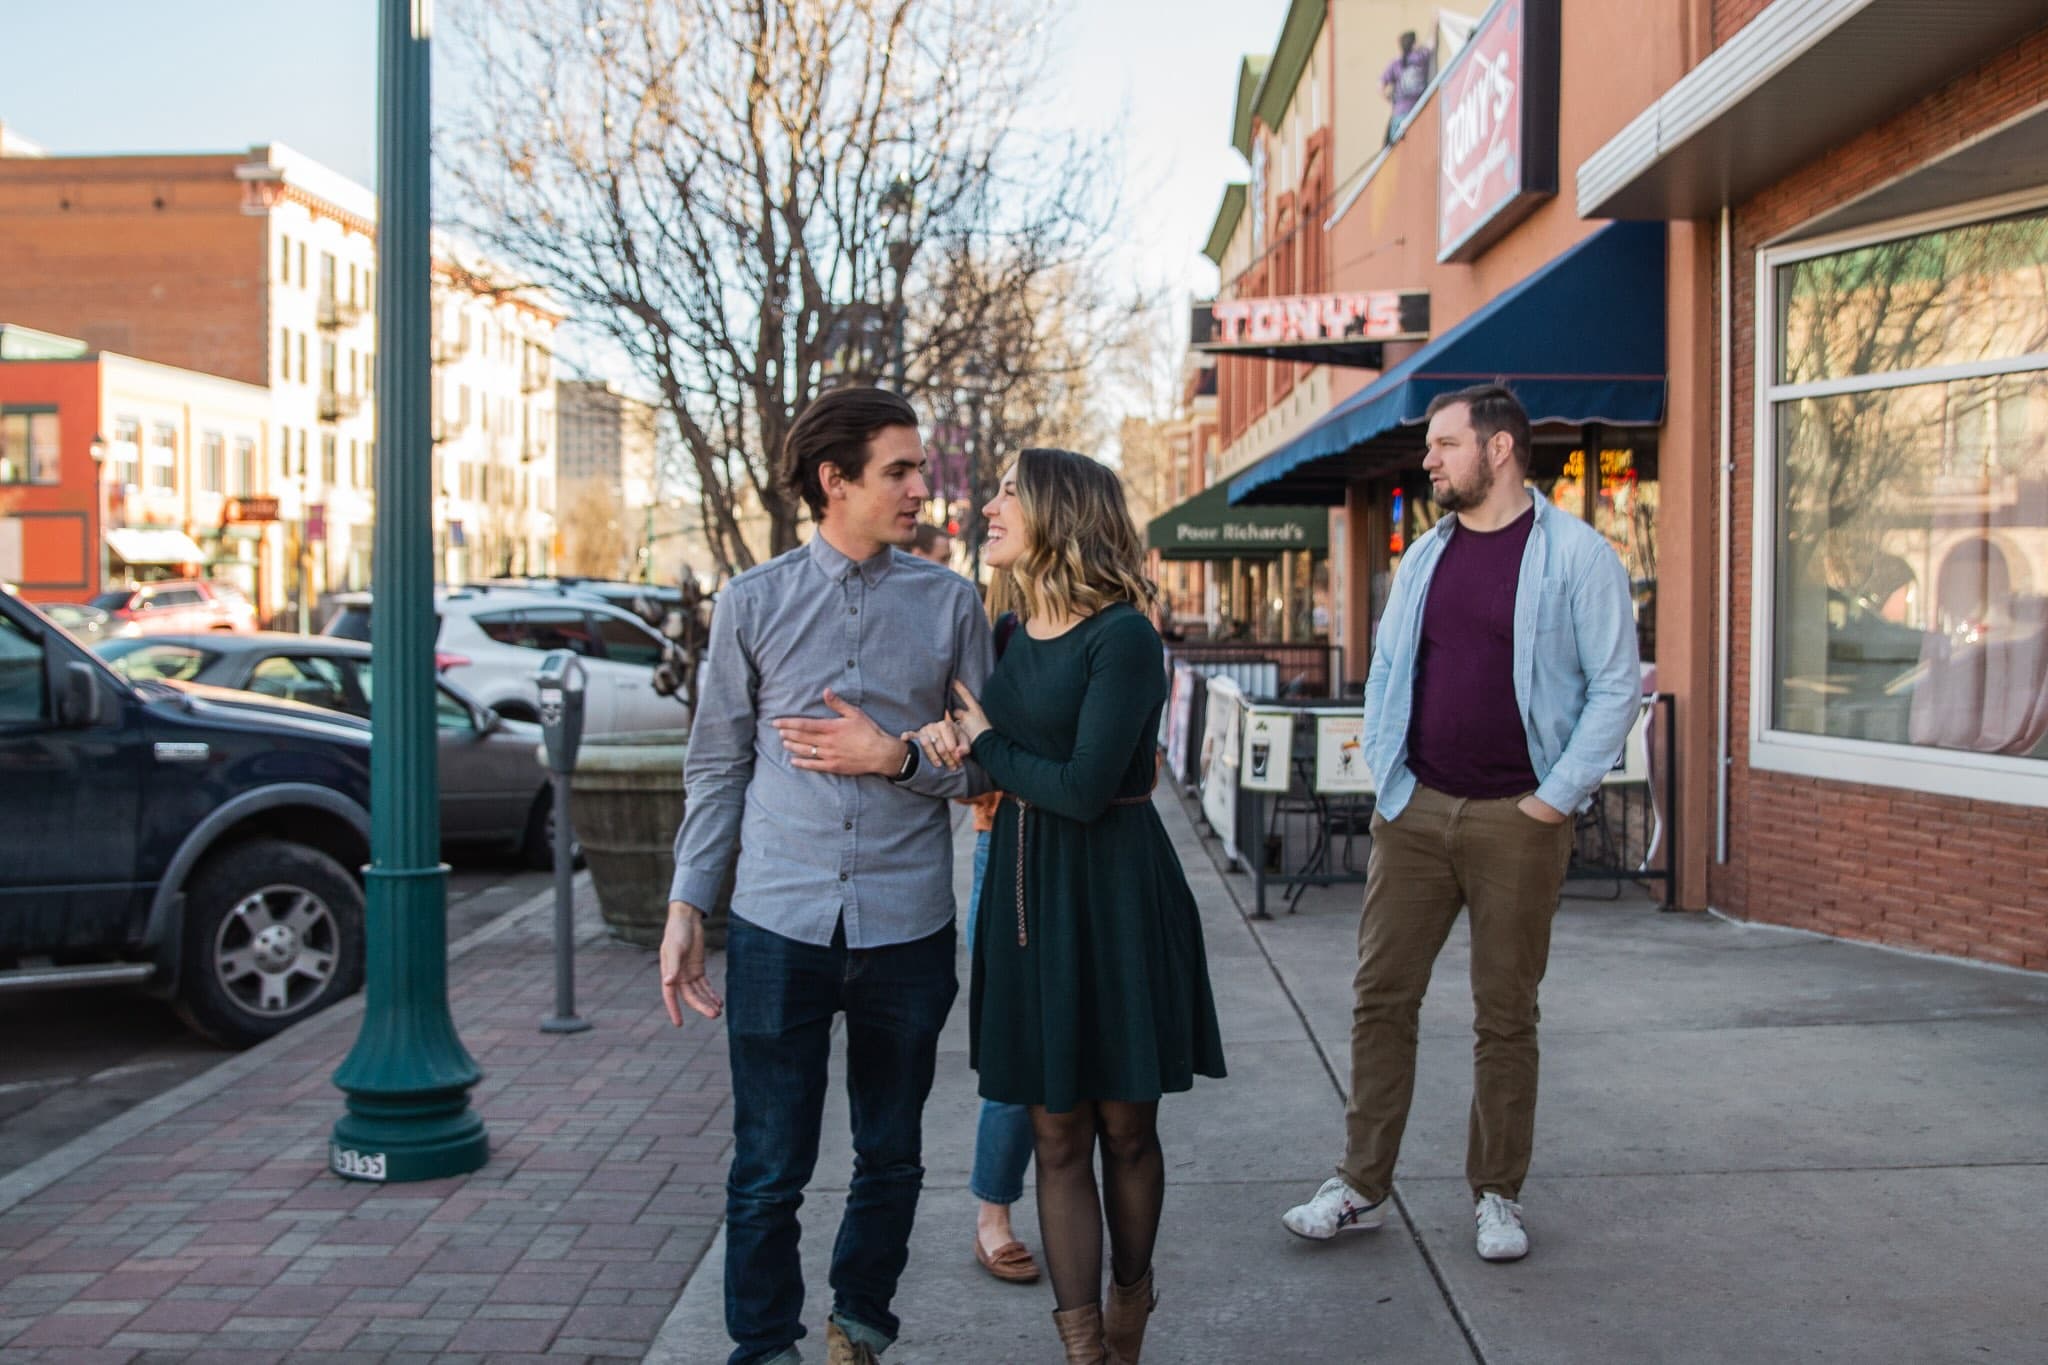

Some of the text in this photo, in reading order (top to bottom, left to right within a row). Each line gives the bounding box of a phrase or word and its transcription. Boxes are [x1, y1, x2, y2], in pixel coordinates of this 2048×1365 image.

[1446, 51, 1513, 173] TONY'S
[1212, 293, 1400, 344] TONY'S
[1176, 521, 1305, 541] Poor Richard's
